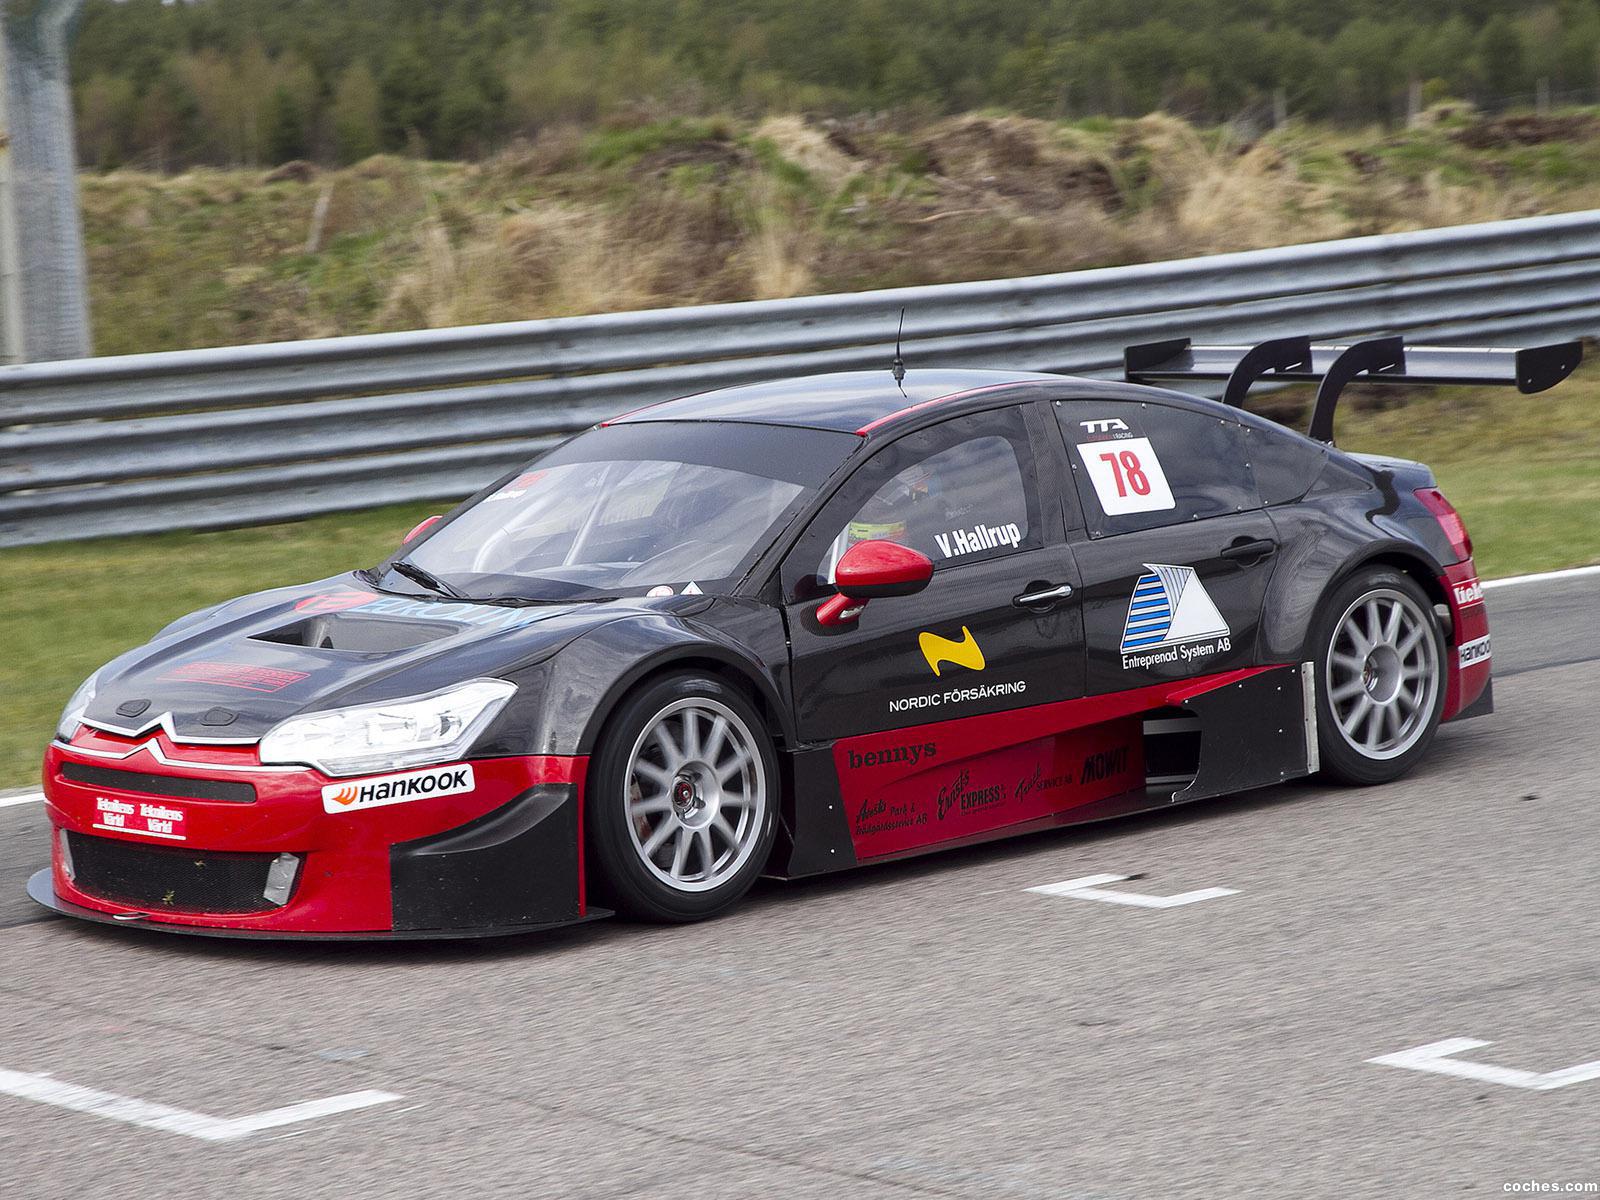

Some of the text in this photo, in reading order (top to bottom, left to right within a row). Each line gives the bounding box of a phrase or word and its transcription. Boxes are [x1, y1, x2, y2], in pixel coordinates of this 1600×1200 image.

[1080, 418, 1129, 434] TTA
[1099, 450, 1151, 497] 78
[934, 521, 1022, 558] V.Hallrup
[1122, 637, 1232, 670] Entreprenad System AB
[889, 680, 1027, 713] NORDIC FÖRSÄKRING
[848, 742, 937, 769] bennys
[961, 785, 1001, 810] EXPRESS
